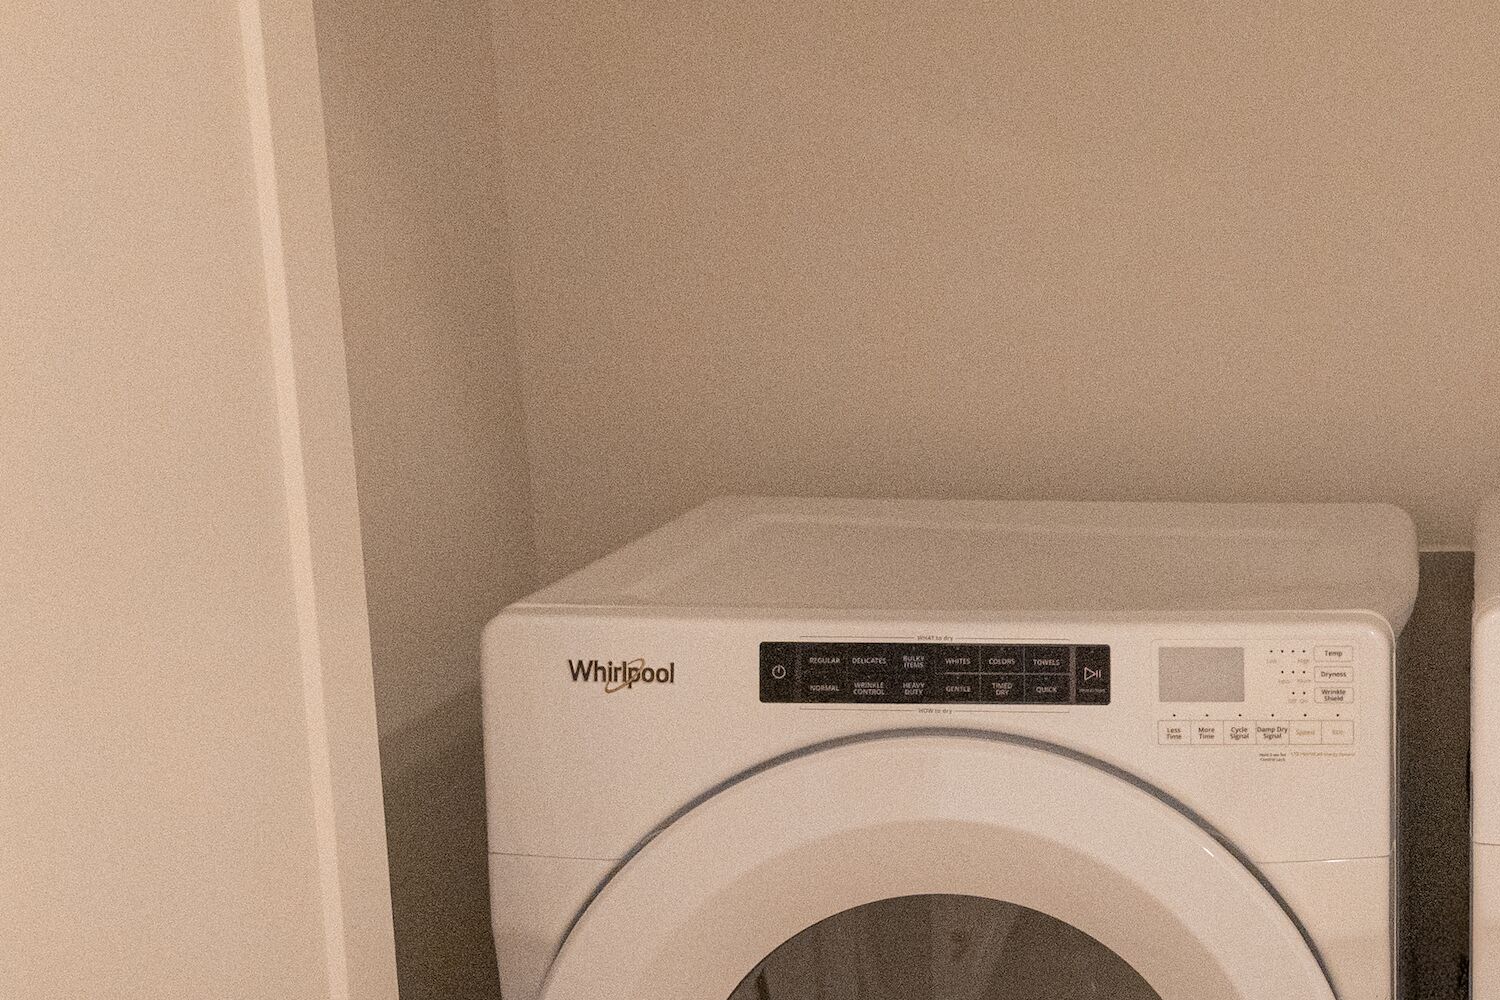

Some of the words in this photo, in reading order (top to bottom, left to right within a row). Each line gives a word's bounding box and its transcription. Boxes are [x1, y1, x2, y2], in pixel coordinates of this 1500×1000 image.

[568, 659, 675, 689] Whirlpool
[1321, 671, 1347, 679] Dryness
[1230, 726, 1248, 734] Cycle
[1230, 733, 1249, 741] Signal
